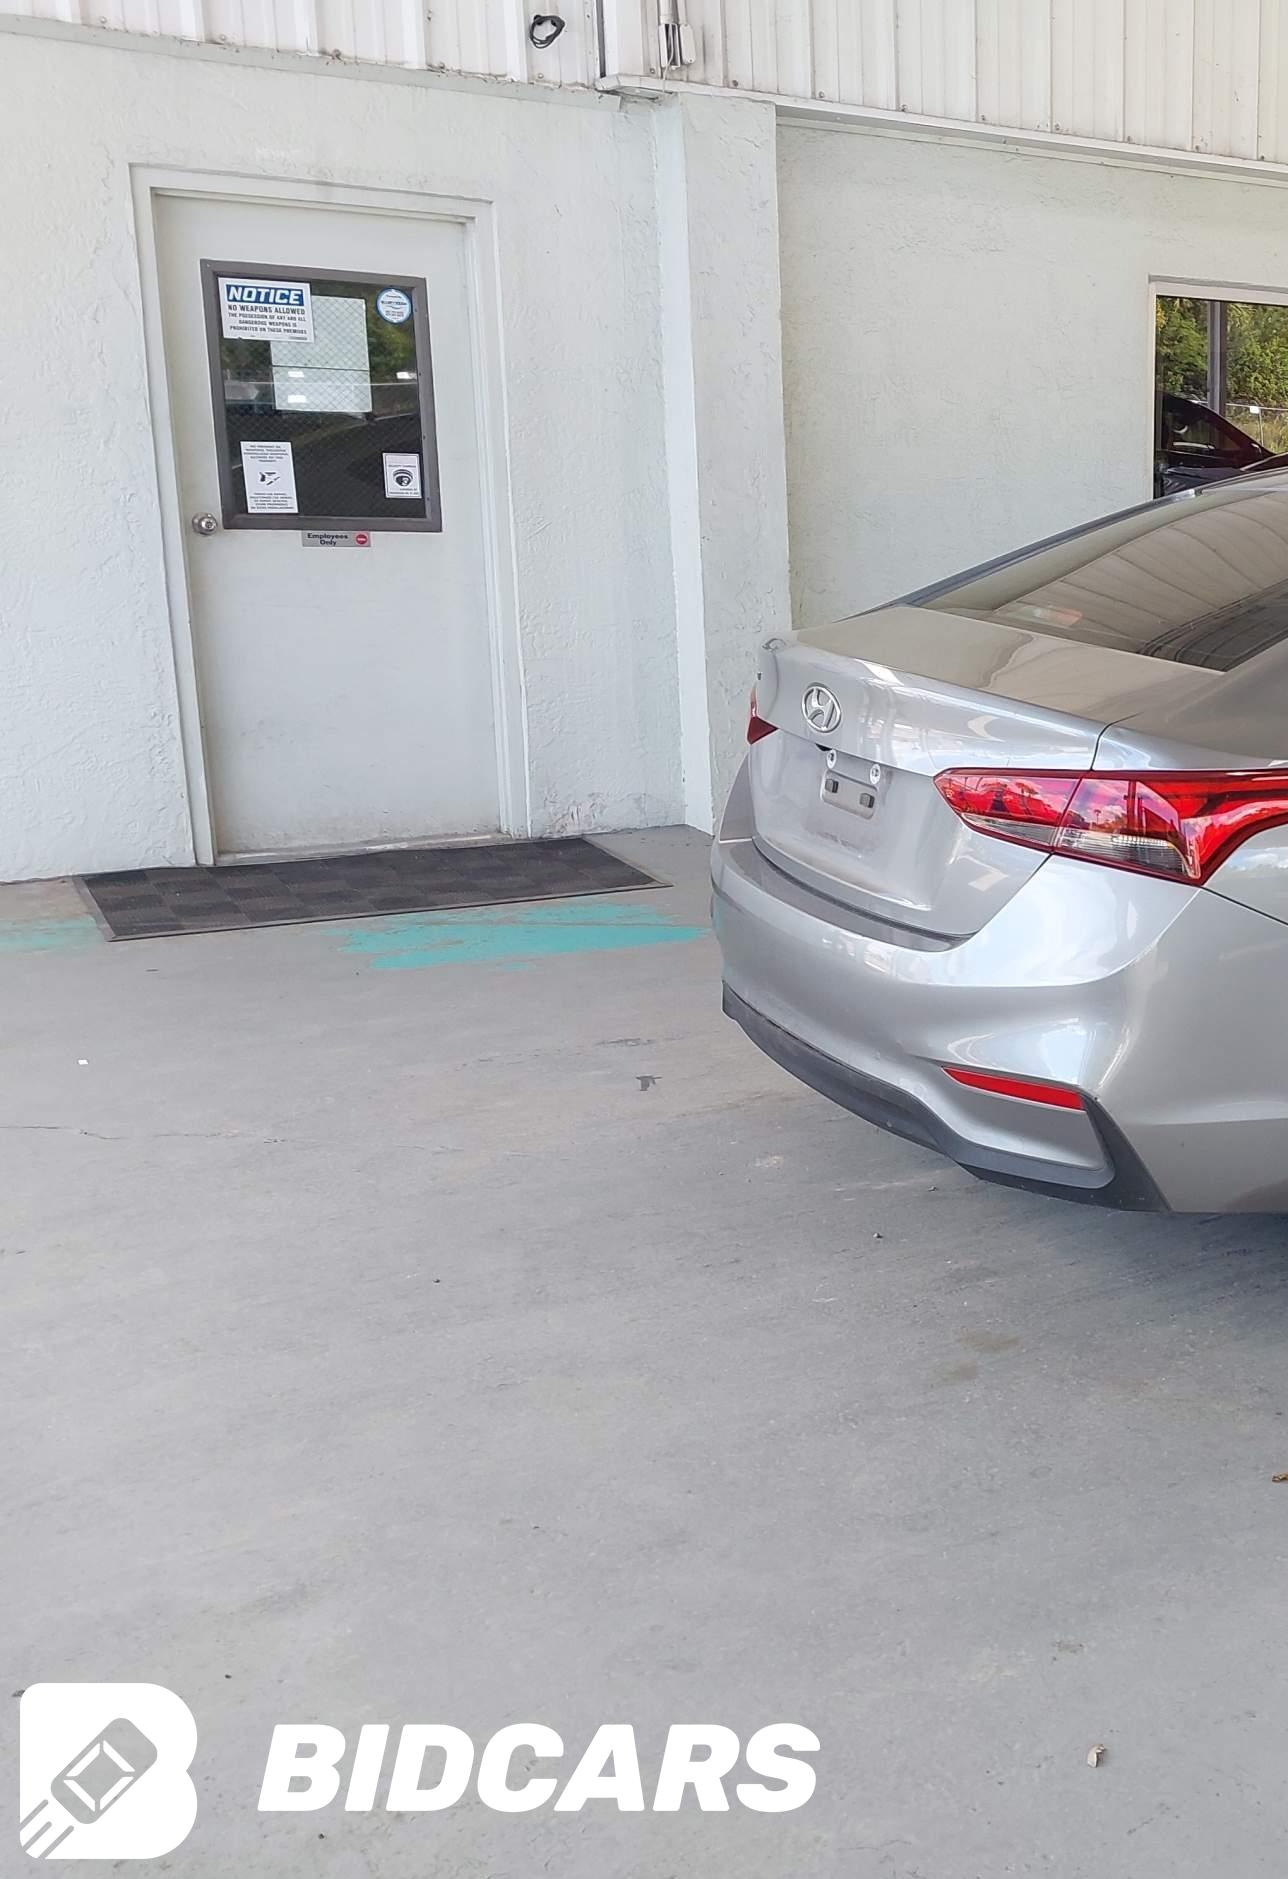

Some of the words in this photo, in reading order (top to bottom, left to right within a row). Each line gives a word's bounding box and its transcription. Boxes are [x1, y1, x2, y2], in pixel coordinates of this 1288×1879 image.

[228, 286, 302, 304] NOTICE
[239, 305, 273, 313] WEAPONS
[274, 307, 306, 315] ALLOWED
